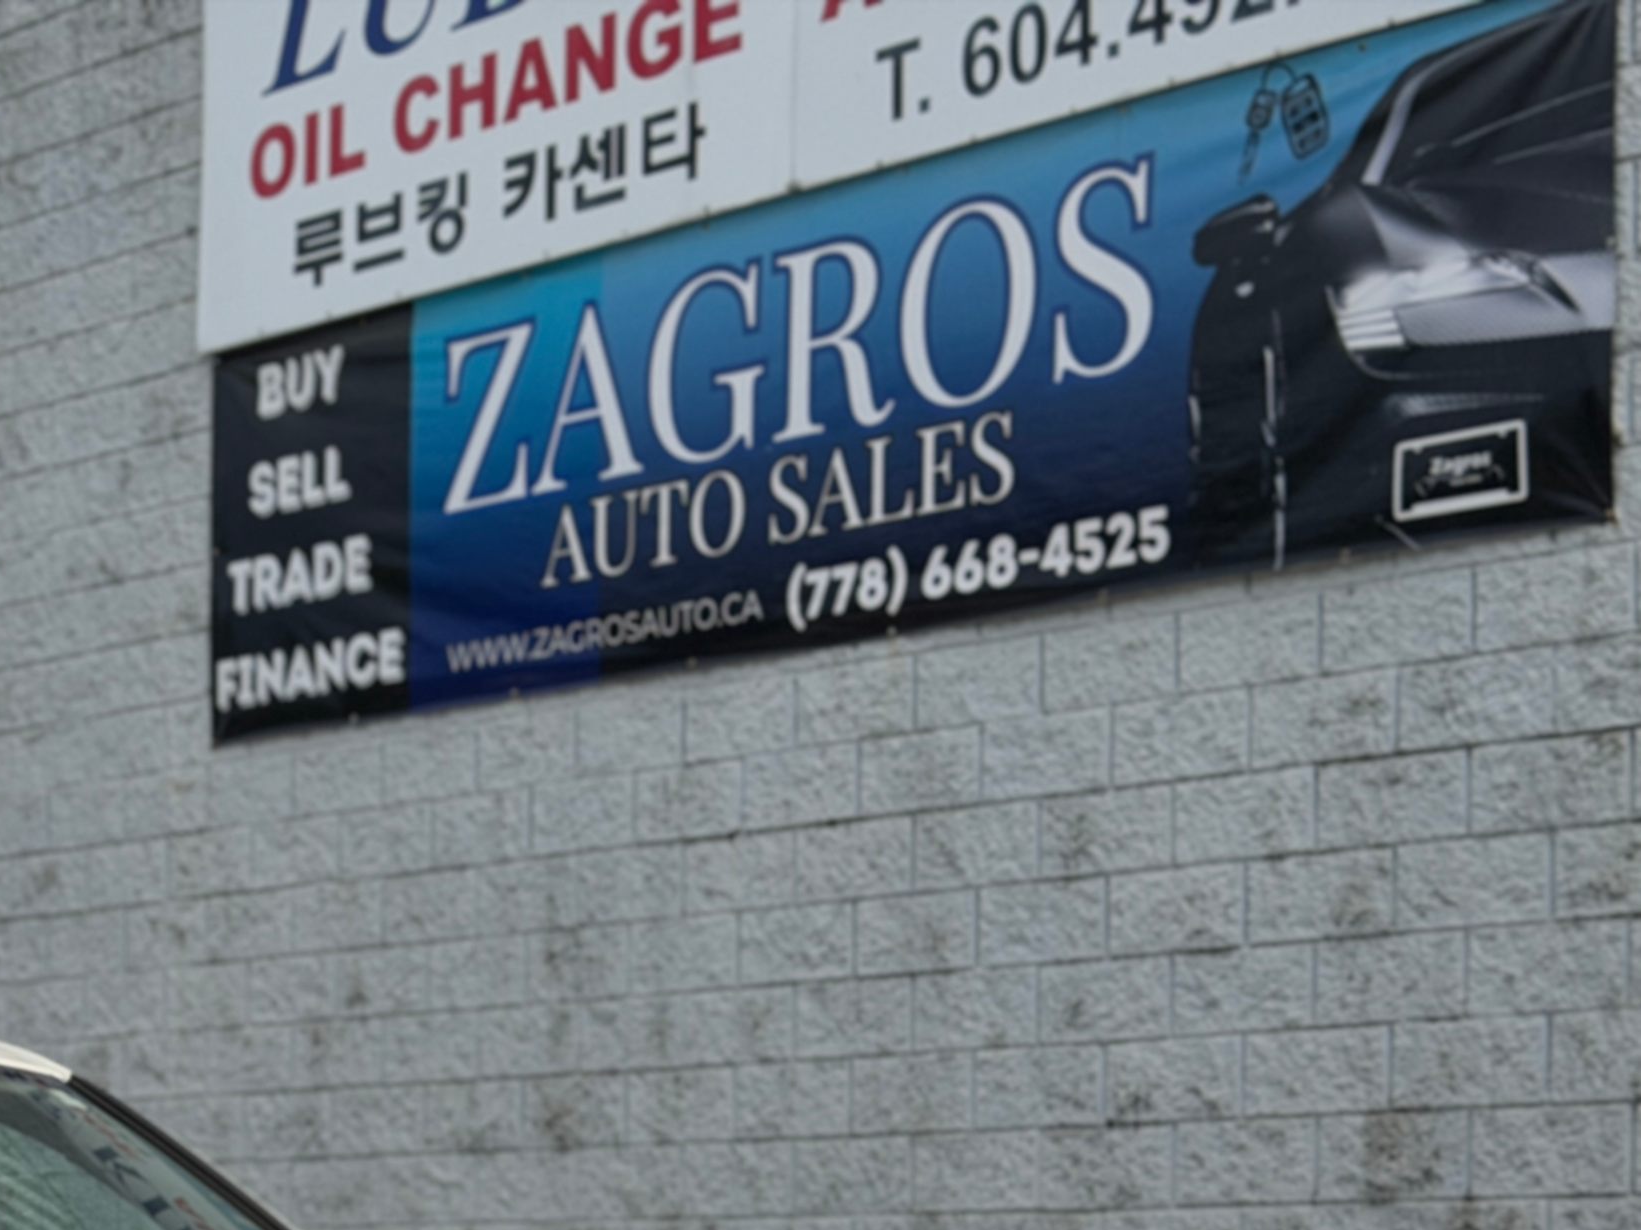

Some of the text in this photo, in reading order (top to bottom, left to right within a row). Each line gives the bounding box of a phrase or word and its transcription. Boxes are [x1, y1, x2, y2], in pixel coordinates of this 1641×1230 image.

[250, 0, 743, 199] OIL CHANGE
[876, 38, 930, 121] T.
[294, 103, 707, 288] 루브킹 카센타
[444, 154, 1155, 516] ZAGROS
[256, 345, 345, 419] BUY
[248, 446, 352, 518] SELL
[540, 410, 1015, 588] AUTO SALES
[227, 533, 373, 616] TRADE
[785, 505, 1171, 631] (778) 668-4525
[216, 627, 407, 712] FINANCE
[447, 590, 764, 675] WWW.ZAGROSAUTO.CA
